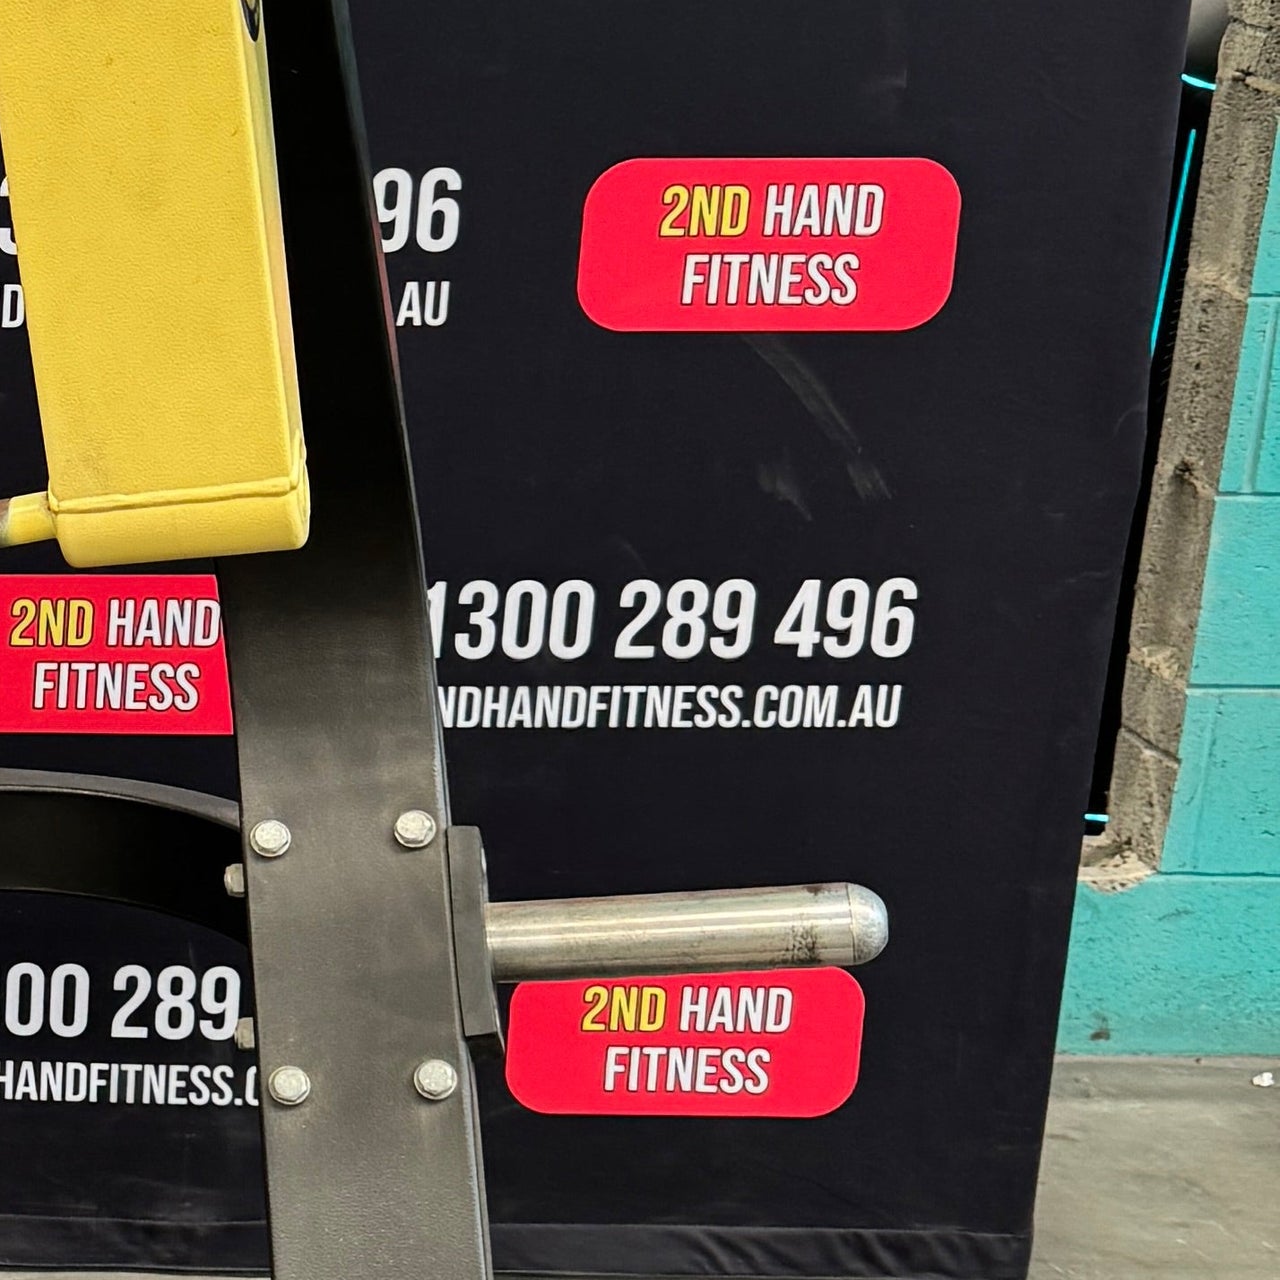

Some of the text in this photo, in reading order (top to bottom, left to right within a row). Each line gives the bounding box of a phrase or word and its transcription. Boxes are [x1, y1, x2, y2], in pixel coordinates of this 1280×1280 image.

[661, 185, 884, 236] 2ND HAND
[682, 254, 859, 304] FITNESS
[11, 599, 222, 646] 2ND HAND
[428, 578, 917, 660] 1300 289 496
[35, 663, 199, 710] FITNESS
[111, 965, 241, 1040] 289
[583, 986, 792, 1032] 2ND HAND
[605, 1047, 770, 1093] FITNESS
